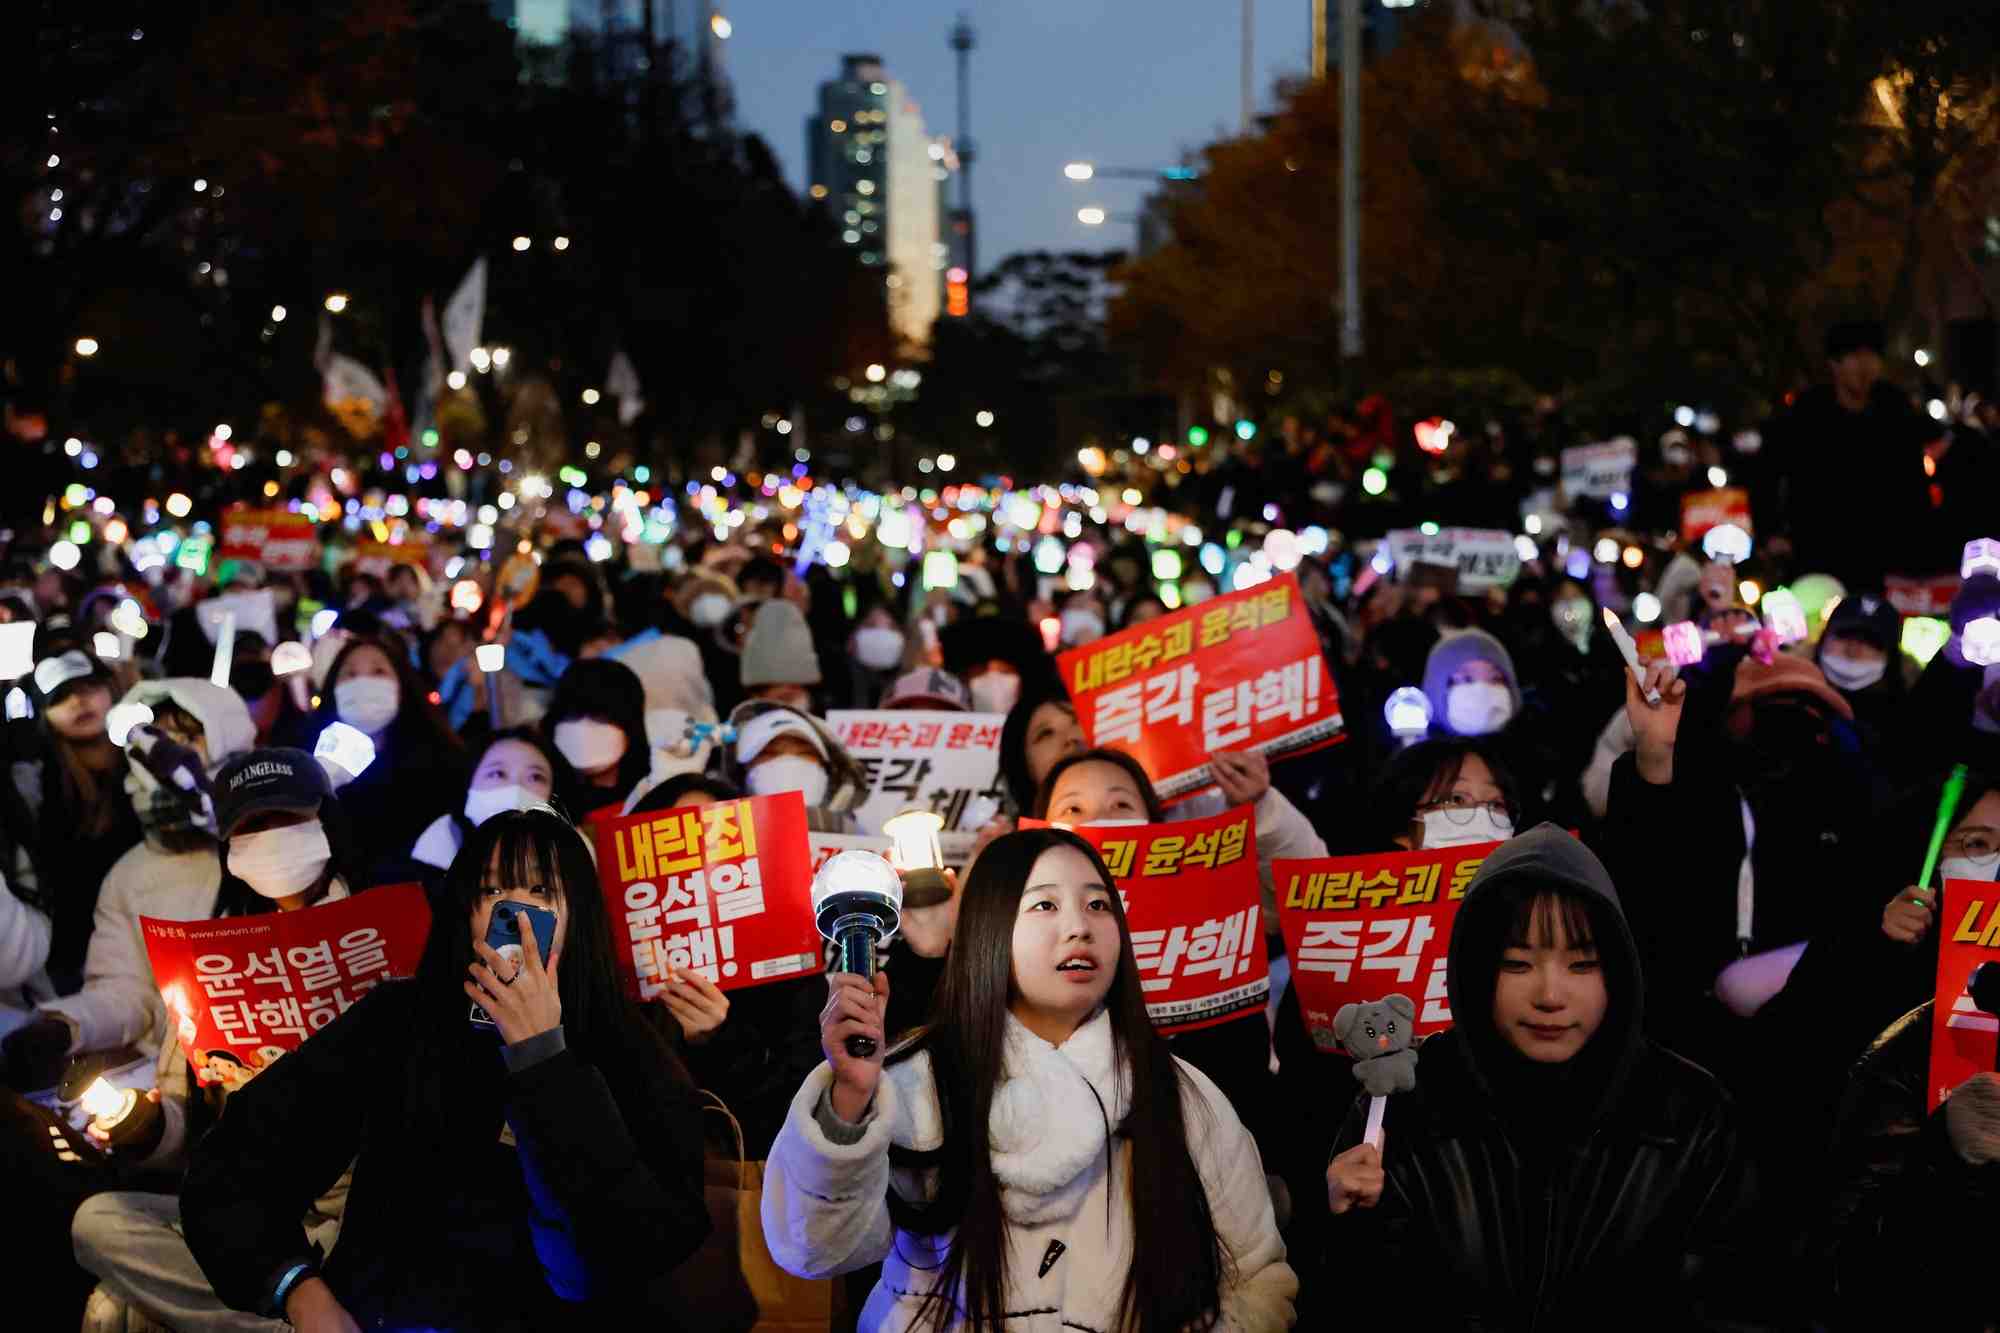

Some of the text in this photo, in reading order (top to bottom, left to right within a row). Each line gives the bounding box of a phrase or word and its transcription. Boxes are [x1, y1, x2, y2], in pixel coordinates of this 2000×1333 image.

[1074, 585, 1290, 694] 내란수괴 윤석열
[945, 722, 1001, 750] 윤석
[1092, 662, 1199, 747] 즉각
[1204, 655, 1321, 752] 탄핵!
[615, 799, 758, 882] 내란죄
[1102, 818, 1249, 877] 괴 윤석열
[624, 857, 766, 941] 윤석열
[1285, 858, 1483, 910] 내란수괴 윤
[195, 928, 388, 998] 윤석열을
[632, 925, 737, 999] 탄핵!
[1130, 905, 1259, 992] 탄핵!
[1297, 915, 1435, 983] 즉각
[210, 975, 378, 1045] 탄핵하
